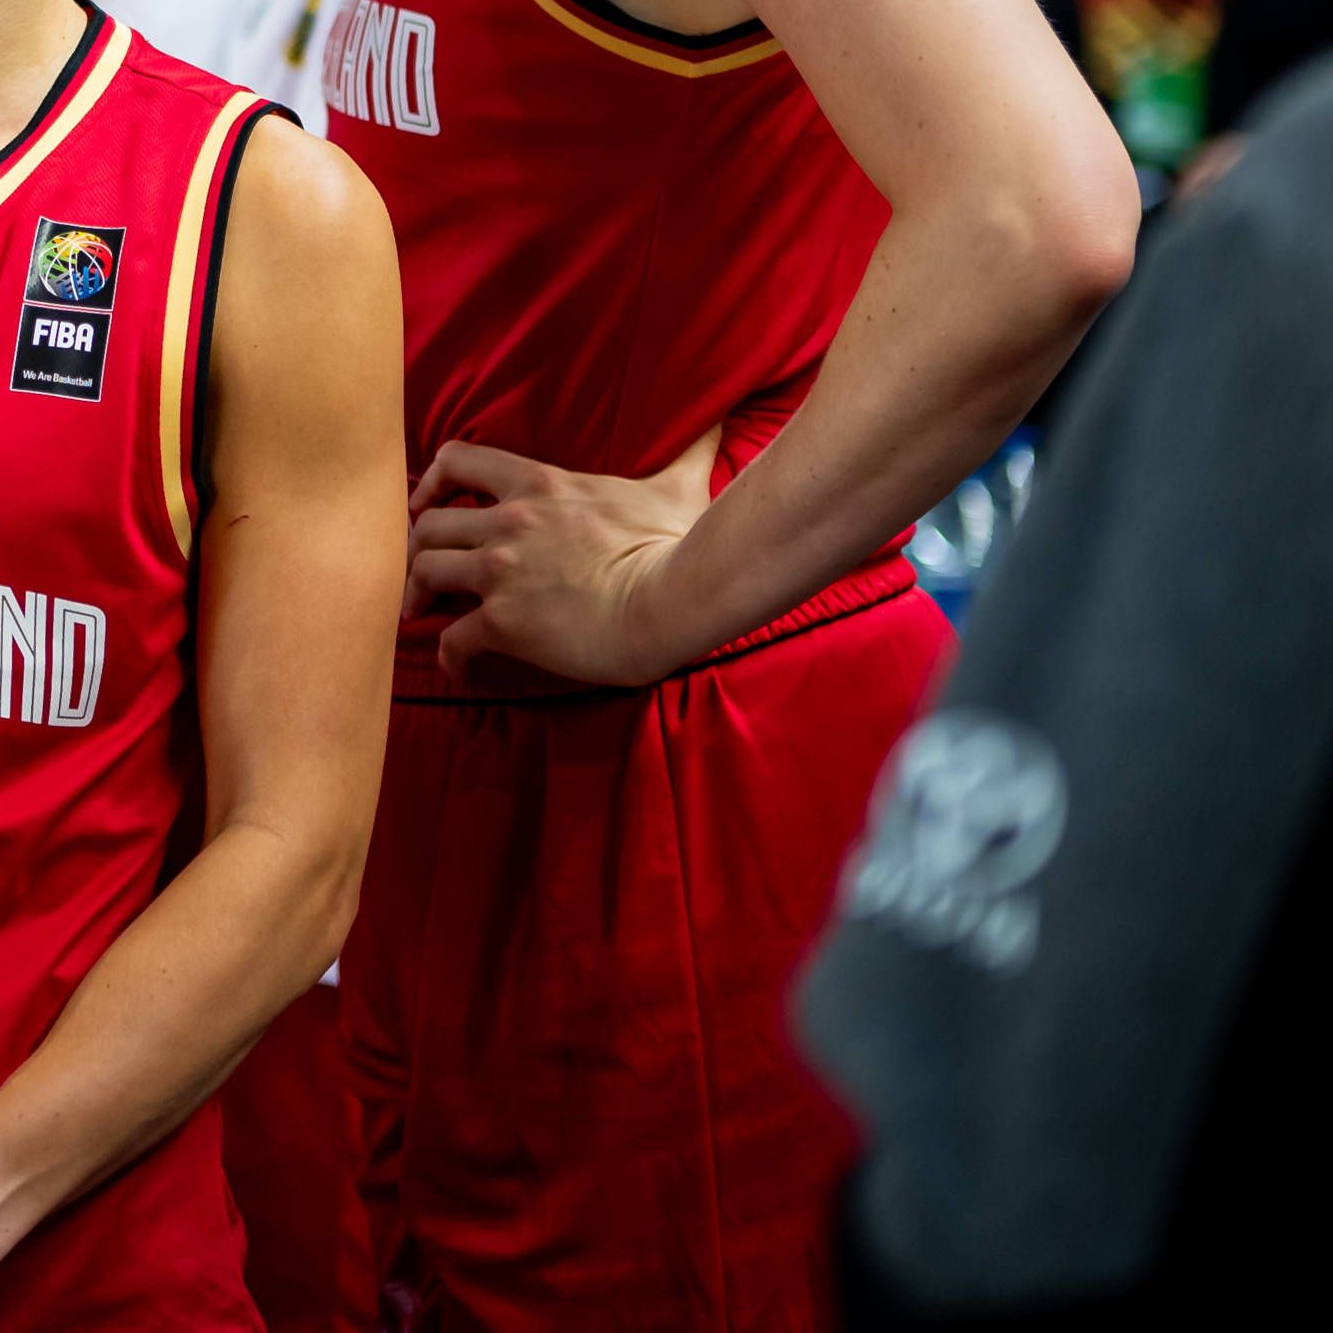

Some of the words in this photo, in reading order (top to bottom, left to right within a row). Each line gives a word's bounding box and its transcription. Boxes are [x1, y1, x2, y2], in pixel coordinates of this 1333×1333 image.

[32, 318, 94, 353] FIBA
[23, 369, 37, 381] We
[37, 370, 52, 382] Are
[52, 372, 93, 388] Basketball
